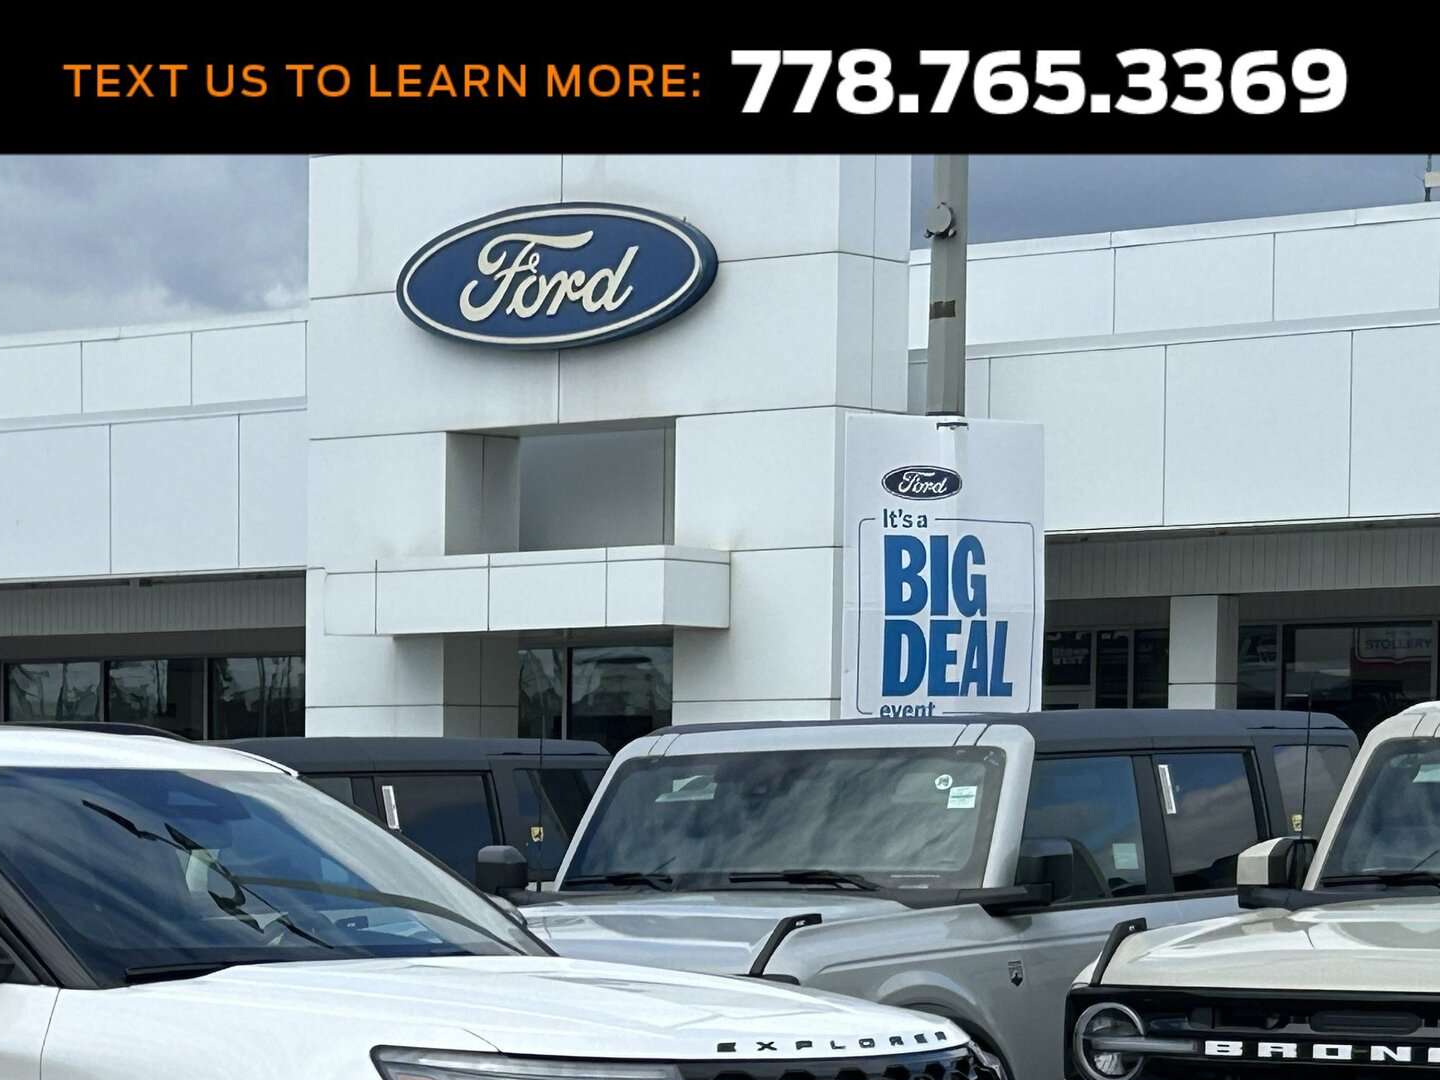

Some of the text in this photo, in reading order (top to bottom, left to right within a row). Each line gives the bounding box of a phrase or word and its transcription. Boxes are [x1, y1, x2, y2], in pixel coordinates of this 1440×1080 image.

[459, 230, 639, 322] Ford
[897, 470, 948, 495] Ford
[883, 508, 928, 528] It's a
[883, 534, 987, 618] BIG
[881, 619, 1014, 697] DEAL
[879, 701, 936, 719] event
[716, 1030, 948, 1053] EXPLORER
